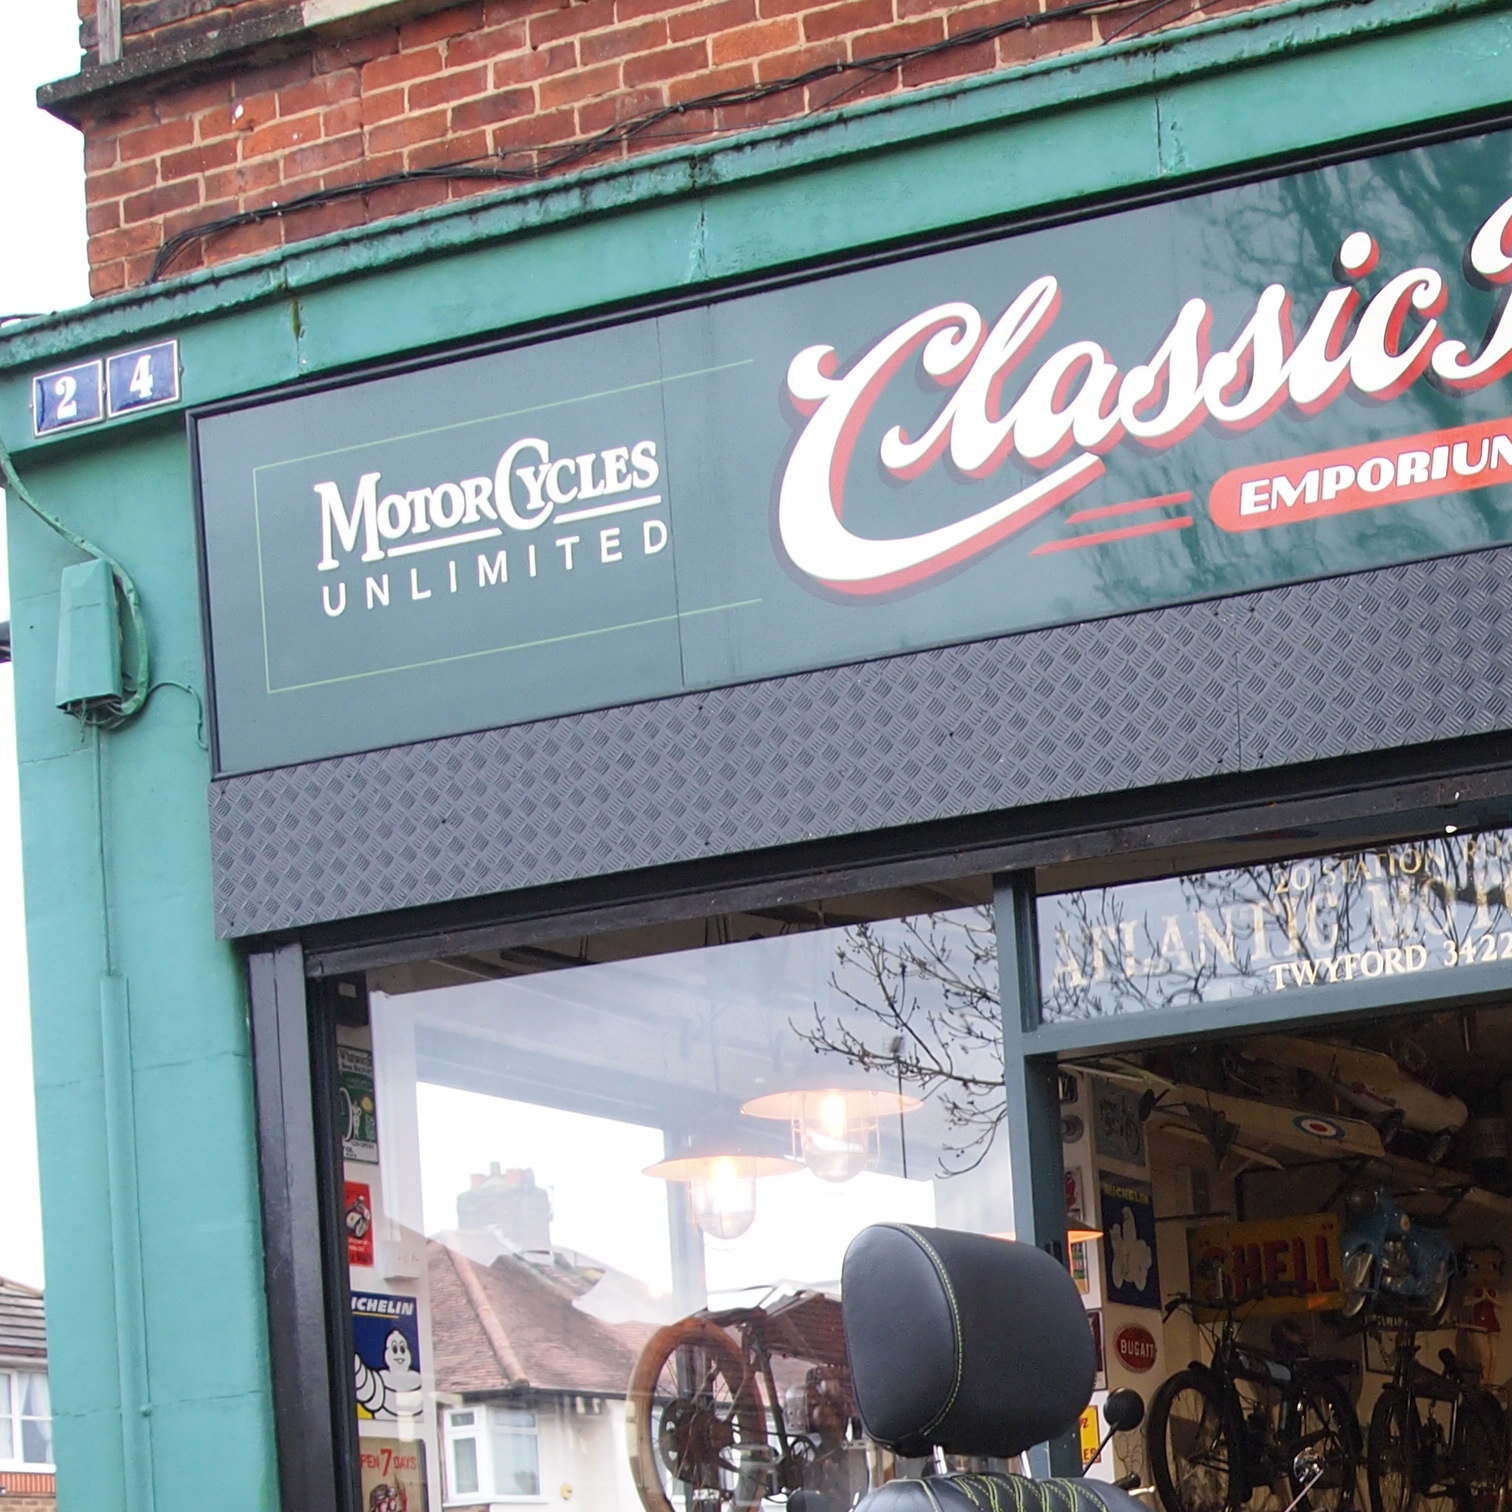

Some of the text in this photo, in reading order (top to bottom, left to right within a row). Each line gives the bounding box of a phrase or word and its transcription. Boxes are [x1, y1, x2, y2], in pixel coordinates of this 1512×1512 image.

[776, 231, 1448, 592] Classic
[322, 519, 668, 617] UNLIMITED
[1274, 866, 1311, 894] 20
[1323, 846, 1447, 885] STATION
[1050, 889, 1340, 990] ATLANTIC
[1269, 944, 1427, 990] TWYFORD
[351, 1297, 413, 1316] ICHELIN
[360, 1448, 417, 1477] PEN 7 DAYS
